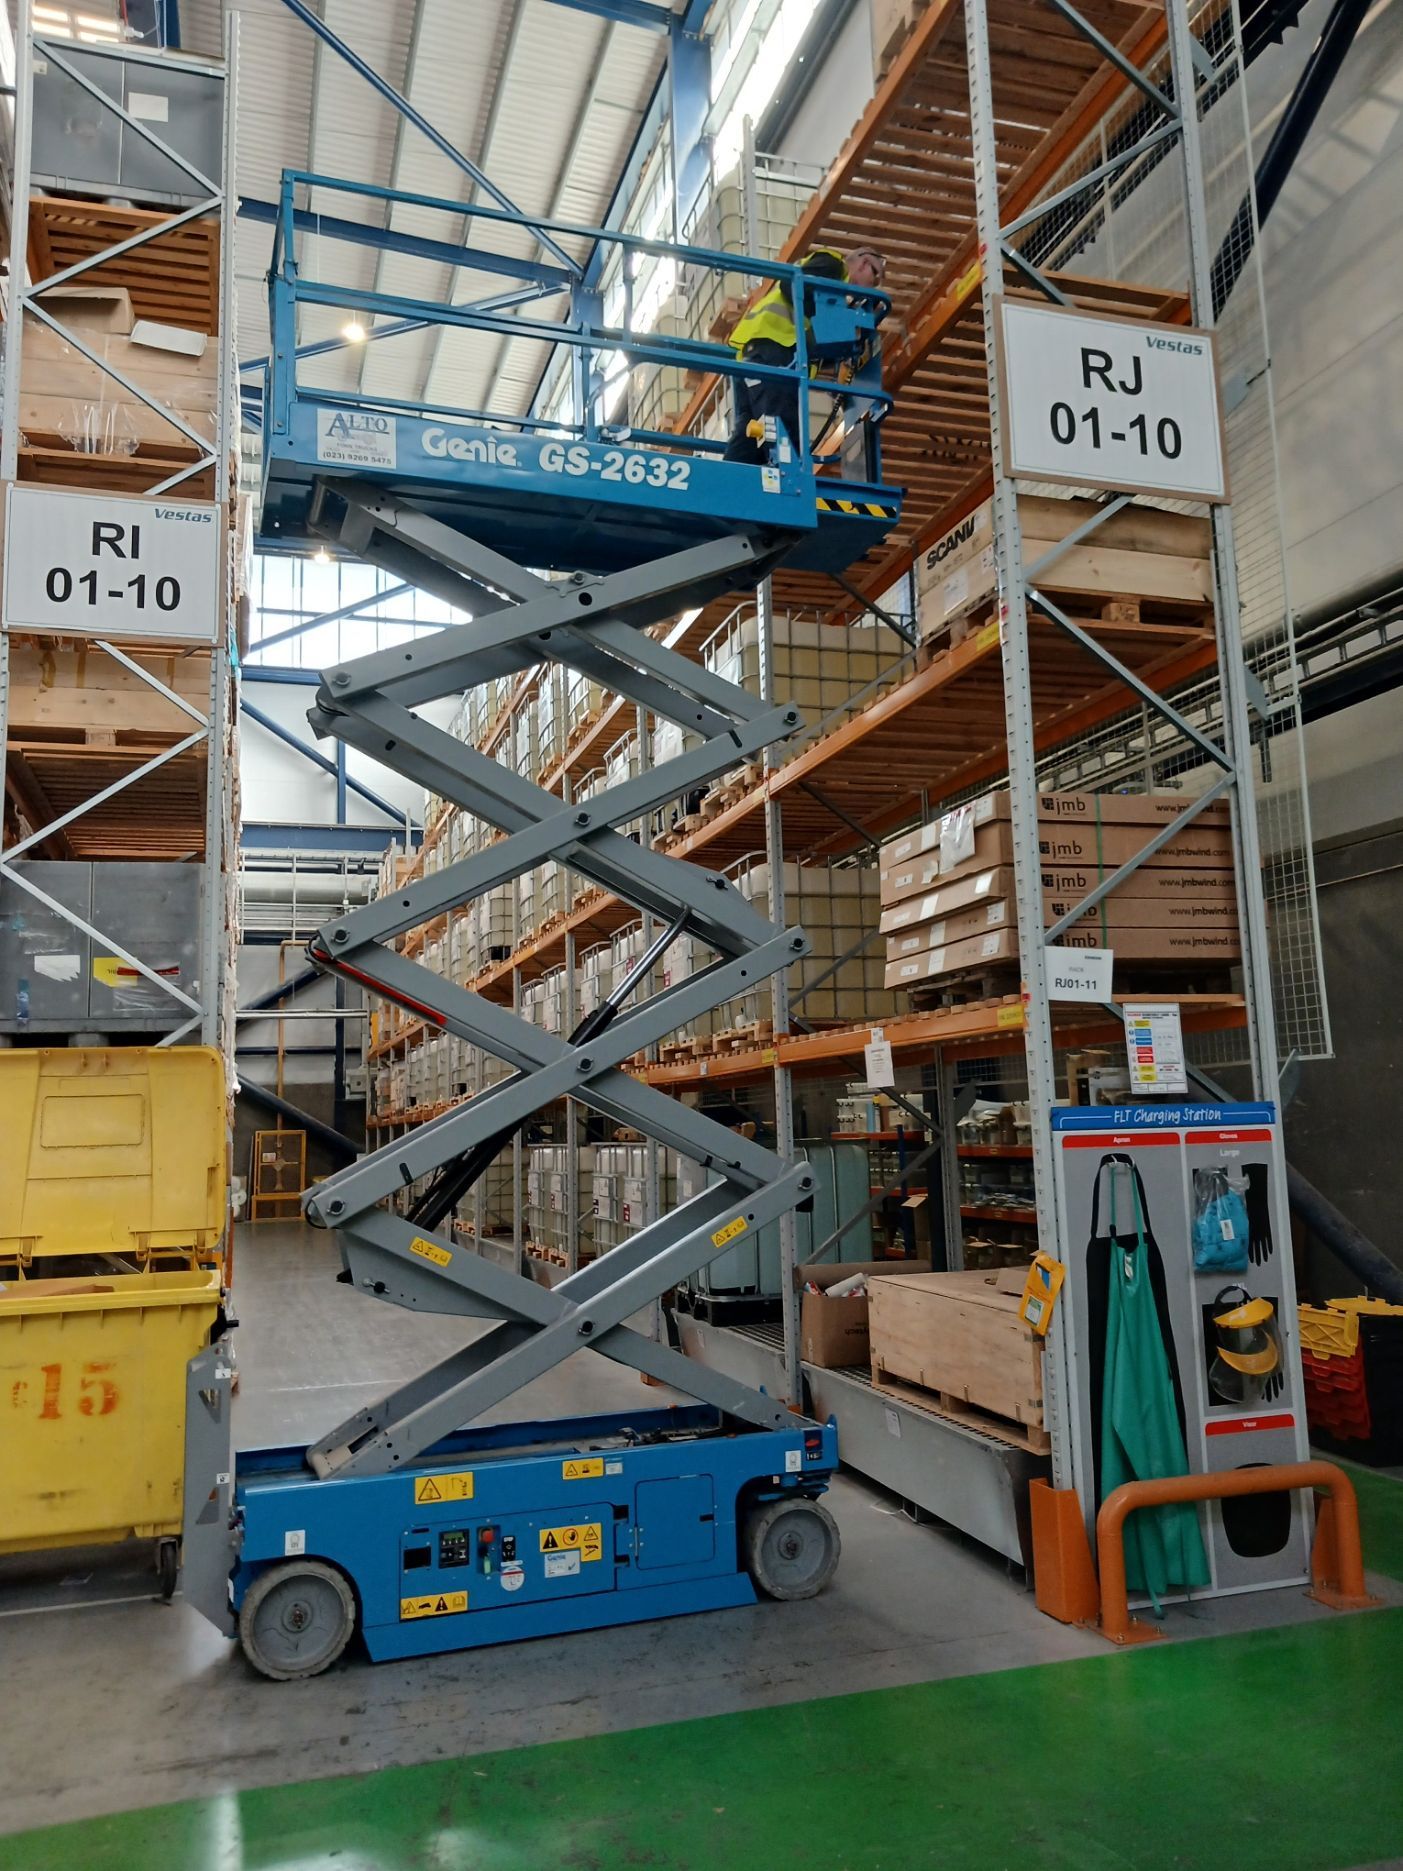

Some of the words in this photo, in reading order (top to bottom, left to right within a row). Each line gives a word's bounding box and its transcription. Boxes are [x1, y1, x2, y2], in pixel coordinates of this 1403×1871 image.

[1146, 336, 1203, 355] Vestas
[1081, 347, 1143, 396] RJ
[325, 412, 390, 439] ALTO
[1050, 402, 1182, 459] 01-10
[421, 427, 519, 467] Genie
[539, 443, 691, 491] GS-2632
[154, 508, 212, 523] Vestas
[92, 521, 140, 559] RI
[46, 567, 181, 611] 01-10
[1056, 797, 1086, 815] jmb
[1052, 840, 1082, 859] jmb
[1056, 873, 1086, 892] jmb
[1055, 978, 1097, 990] RJ01-11
[1114, 1110, 1132, 1123] FLT
[1134, 1109, 1181, 1125] Charging
[1183, 1108, 1222, 1121] Station
[38, 1362, 119, 1420] 15
